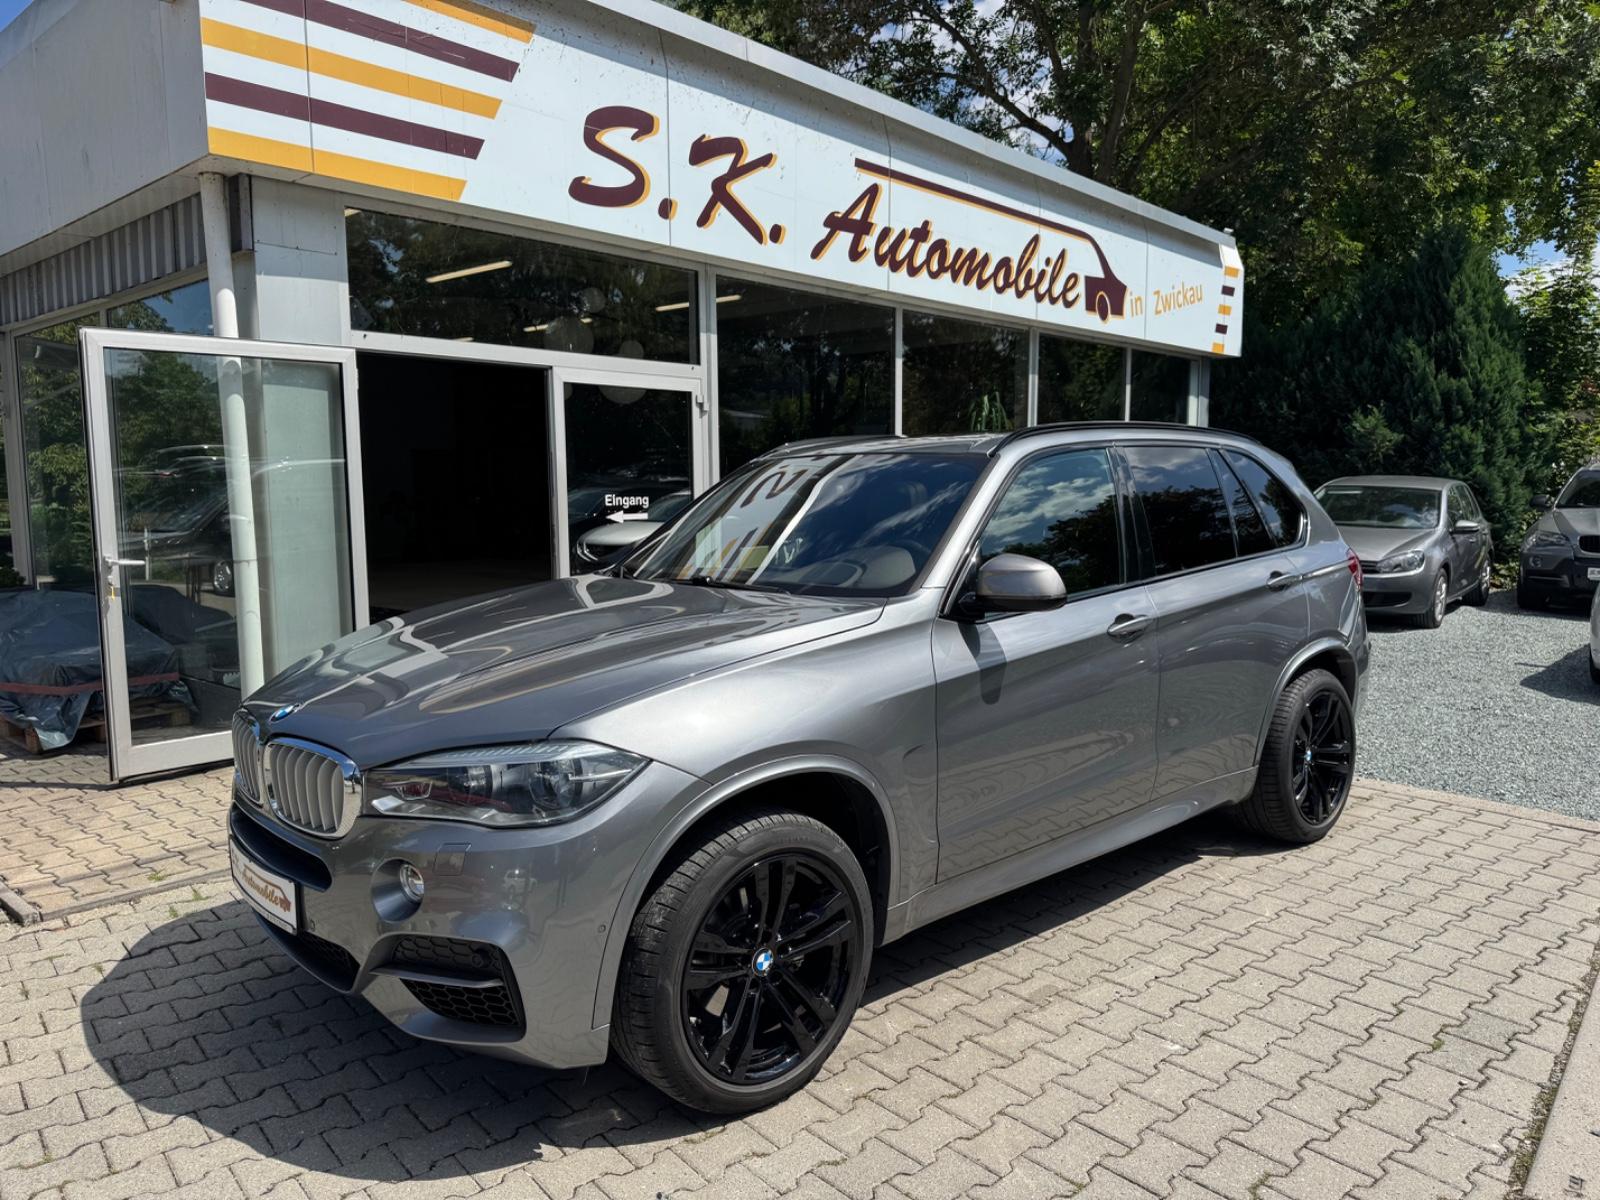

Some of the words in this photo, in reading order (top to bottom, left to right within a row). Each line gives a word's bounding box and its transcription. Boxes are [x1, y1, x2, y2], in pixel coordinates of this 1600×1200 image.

[810, 183, 1081, 309] Automobile
[1130, 290, 1143, 317] in
[1152, 280, 1203, 316] Zwickau
[604, 494, 650, 509] Eingang
